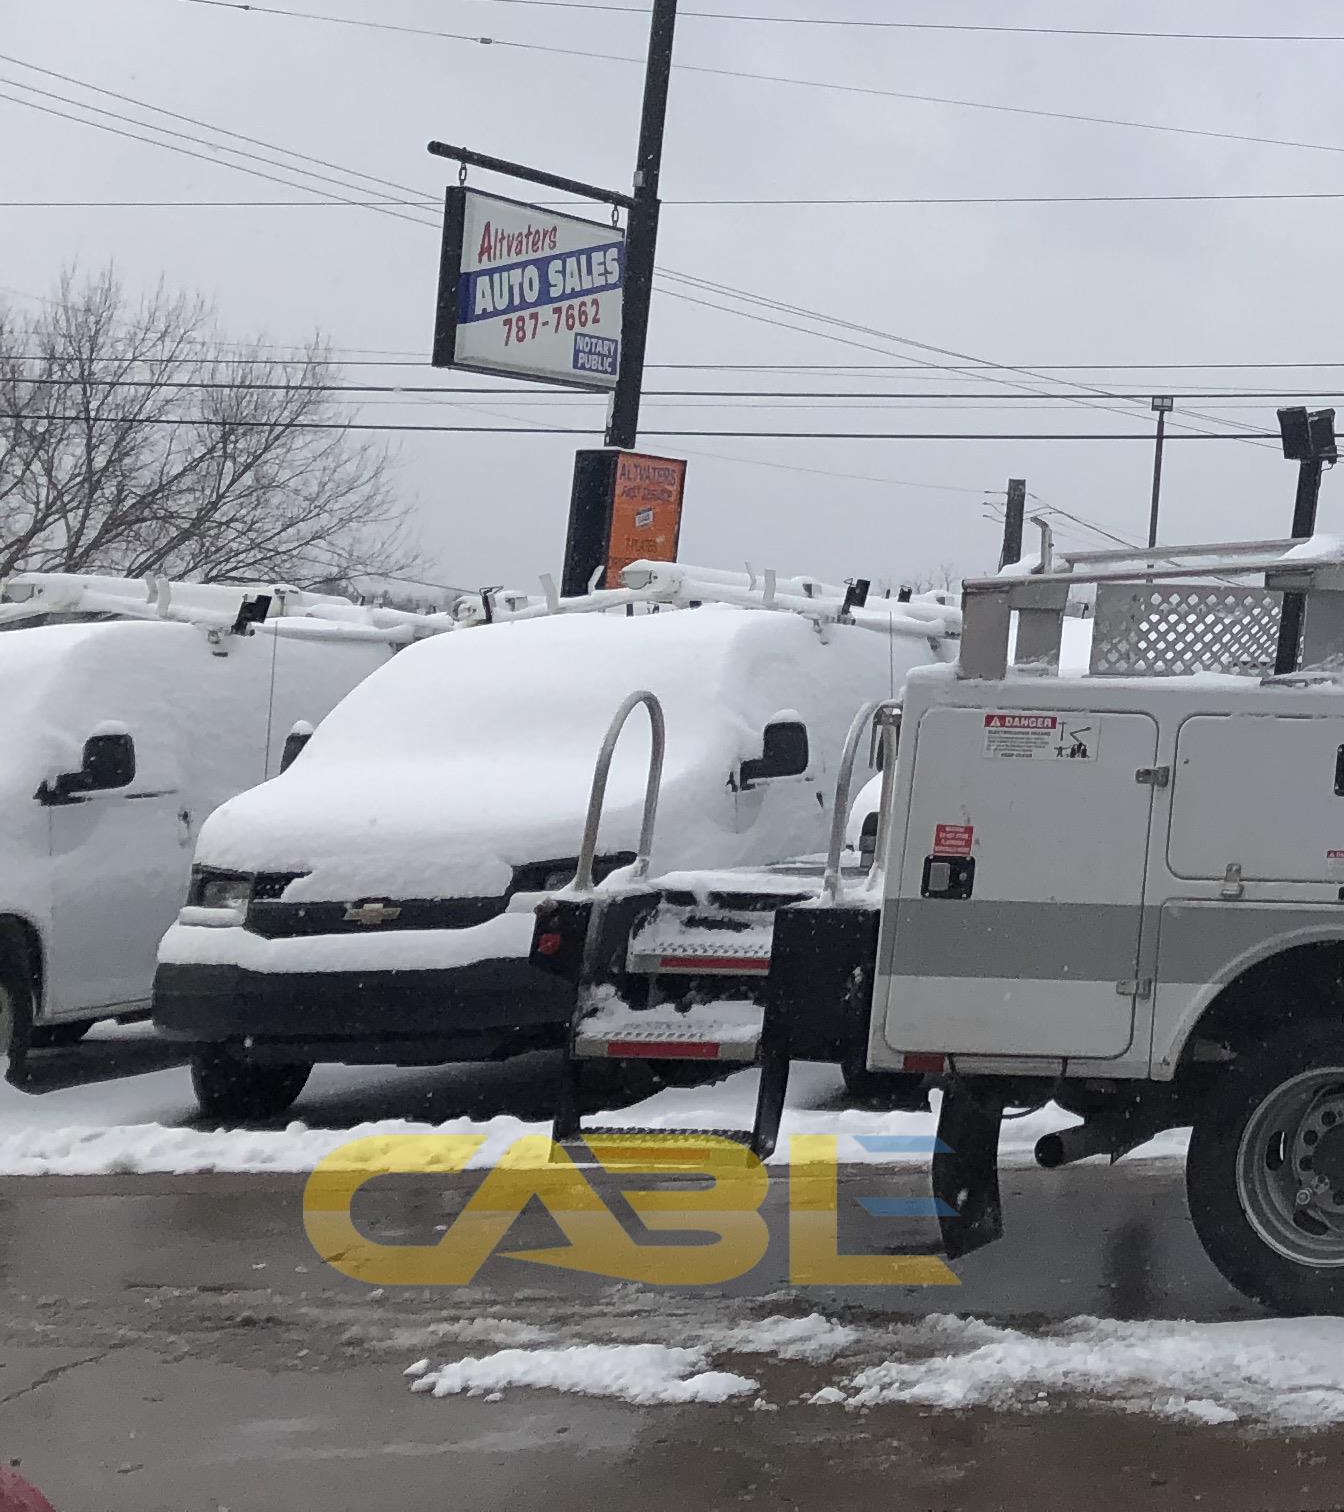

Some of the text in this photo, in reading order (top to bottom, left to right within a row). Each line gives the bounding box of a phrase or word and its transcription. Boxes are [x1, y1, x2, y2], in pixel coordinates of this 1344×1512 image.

[478, 221, 557, 264] Altvaters
[474, 248, 620, 316] AUTO SALES
[502, 298, 600, 346] 787-7662
[576, 335, 615, 356] NOTARY
[578, 352, 612, 372] PUBLIC
[1004, 716, 1052, 728] DANGER
